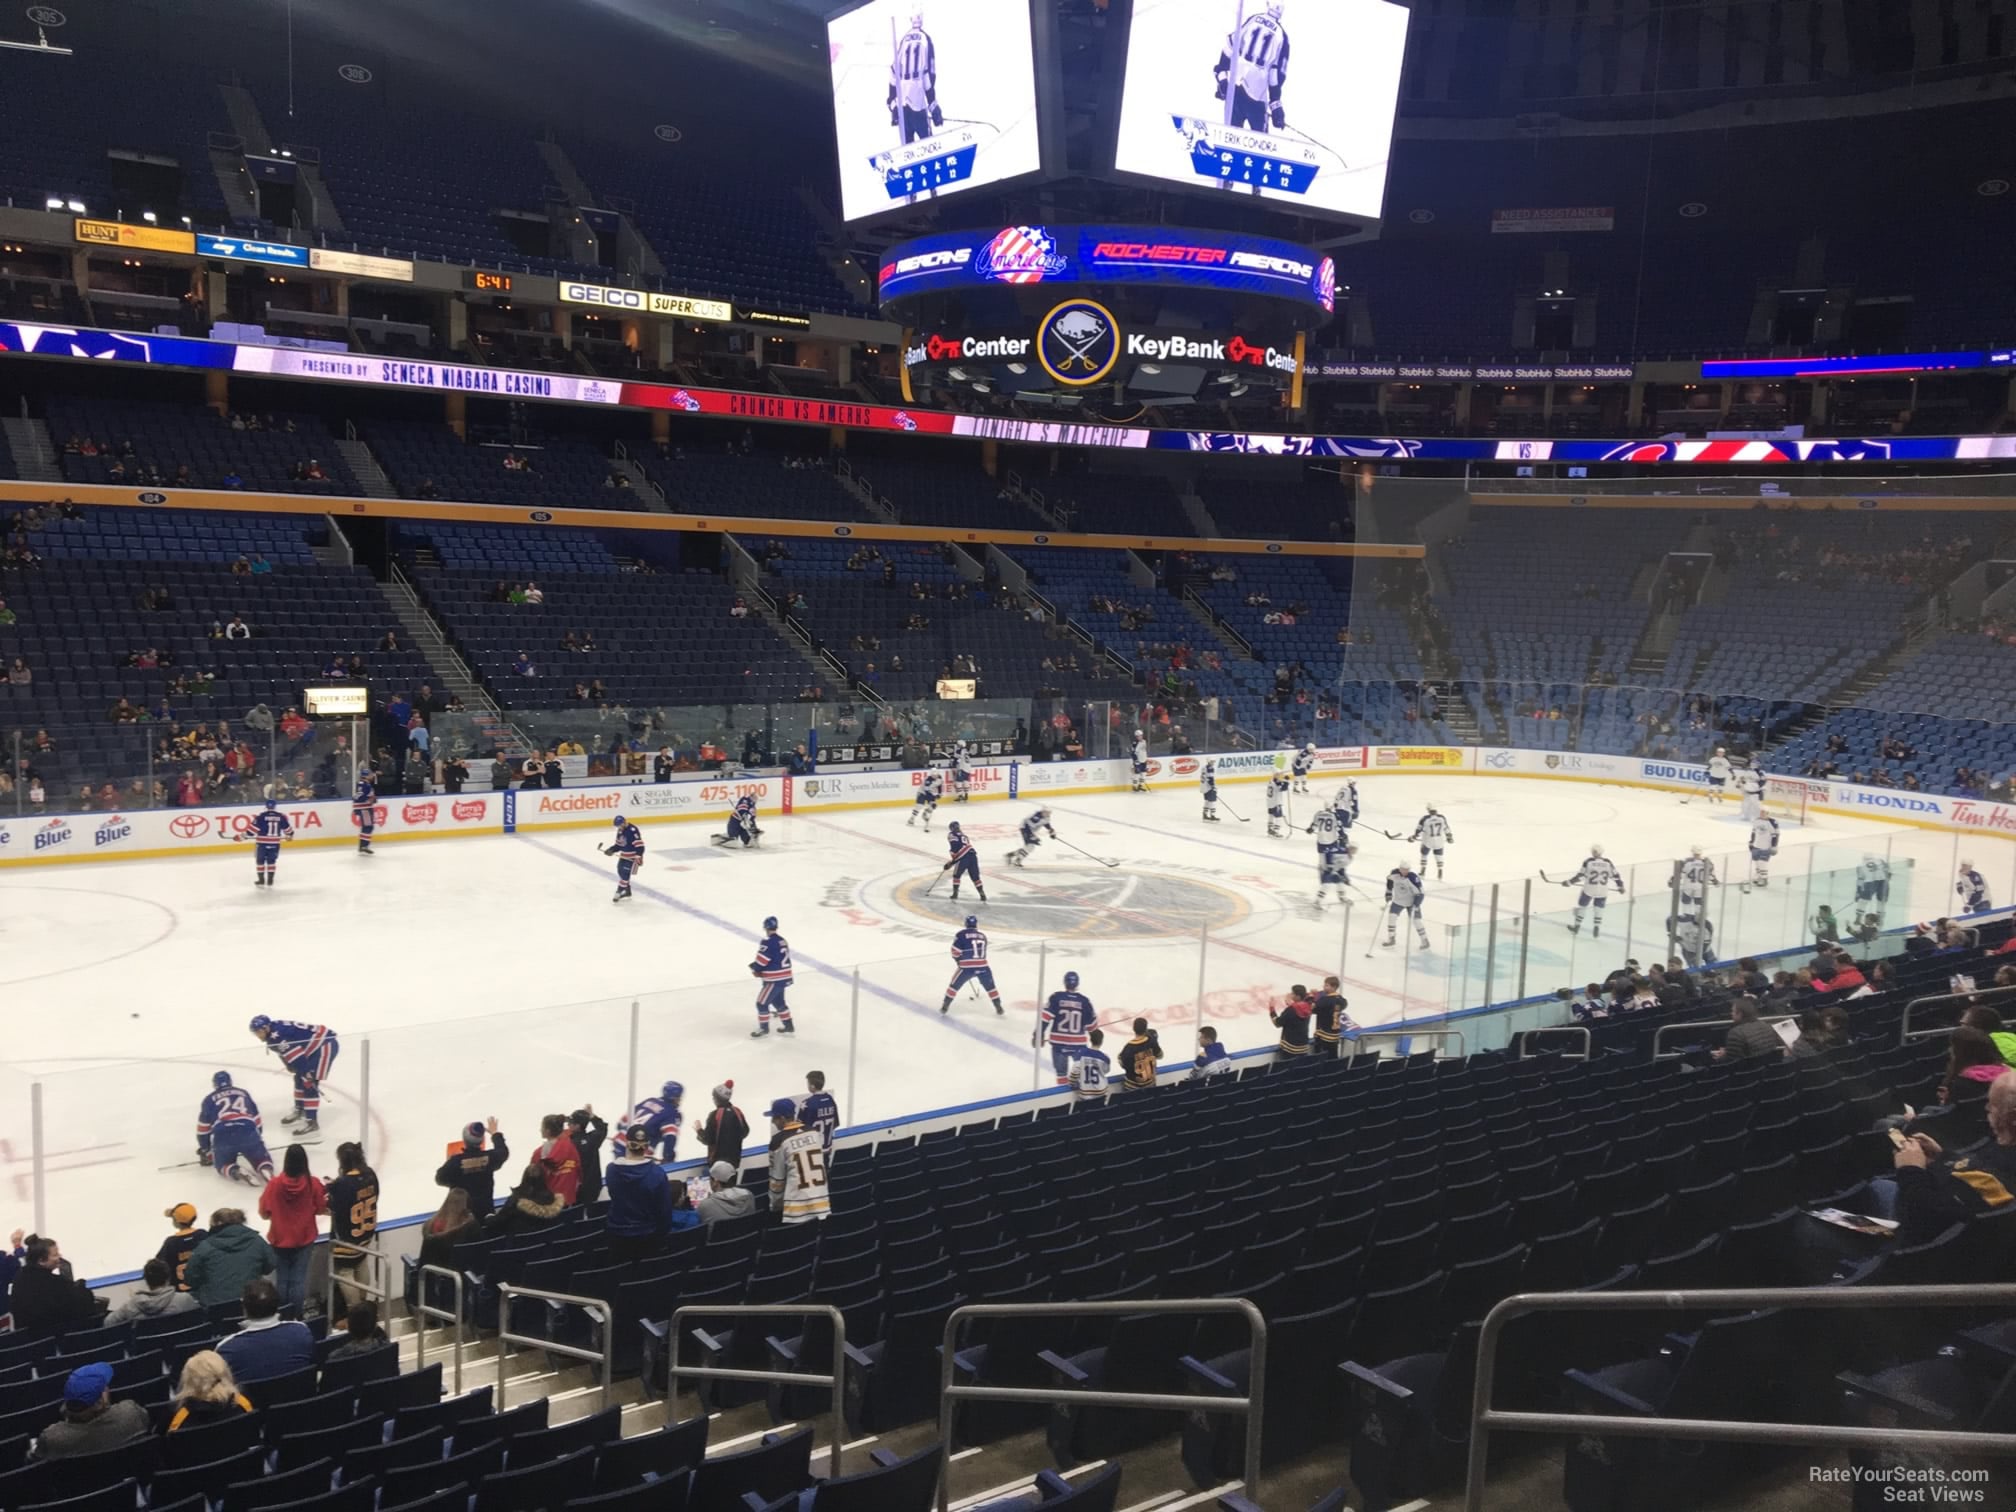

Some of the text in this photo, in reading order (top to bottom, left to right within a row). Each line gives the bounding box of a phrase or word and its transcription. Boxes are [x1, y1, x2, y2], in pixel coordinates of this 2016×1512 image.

[1224, 132, 1242, 146] ERIK
[1242, 136, 1277, 152] CONDRA
[82, 223, 118, 237] HUNT
[1093, 242, 1227, 263] ROCHESTER
[476, 273, 511, 290] 6:41
[569, 285, 640, 307] GEICO
[654, 297, 724, 317] SUPERCUTS
[962, 336, 1031, 357] Center
[1127, 334, 1225, 360] KeyBank
[302, 359, 551, 396] PRESENTED BY SENECA NIAGARA CASINO
[731, 395, 871, 425] CRUNCH VS AMERKS
[1518, 443, 1532, 459] VS
[1218, 754, 1274, 768] ADVANTAGE
[1561, 755, 1583, 769] UR
[1644, 764, 1677, 778] BUD
[645, 789, 673, 797] SEGAR
[700, 783, 768, 801] 475-1100
[820, 779, 842, 793] UR
[539, 792, 622, 813] Accident?
[630, 793, 641, 806] &
[1857, 792, 1941, 814] HONDA
[215, 810, 323, 833] TOTA
[1952, 801, 1985, 827] Tim
[267, 821, 278, 837] 11
[1318, 818, 1332, 832] 78
[1429, 822, 1442, 837] 17
[34, 828, 72, 850] Blue
[95, 825, 131, 846] Blue
[1588, 870, 1609, 885] 23
[971, 939, 986, 959] 17
[1058, 1009, 1082, 1033] 20
[1083, 1065, 1099, 1085] 15
[216, 1096, 248, 1119] 24
[793, 1148, 827, 1190] 15
